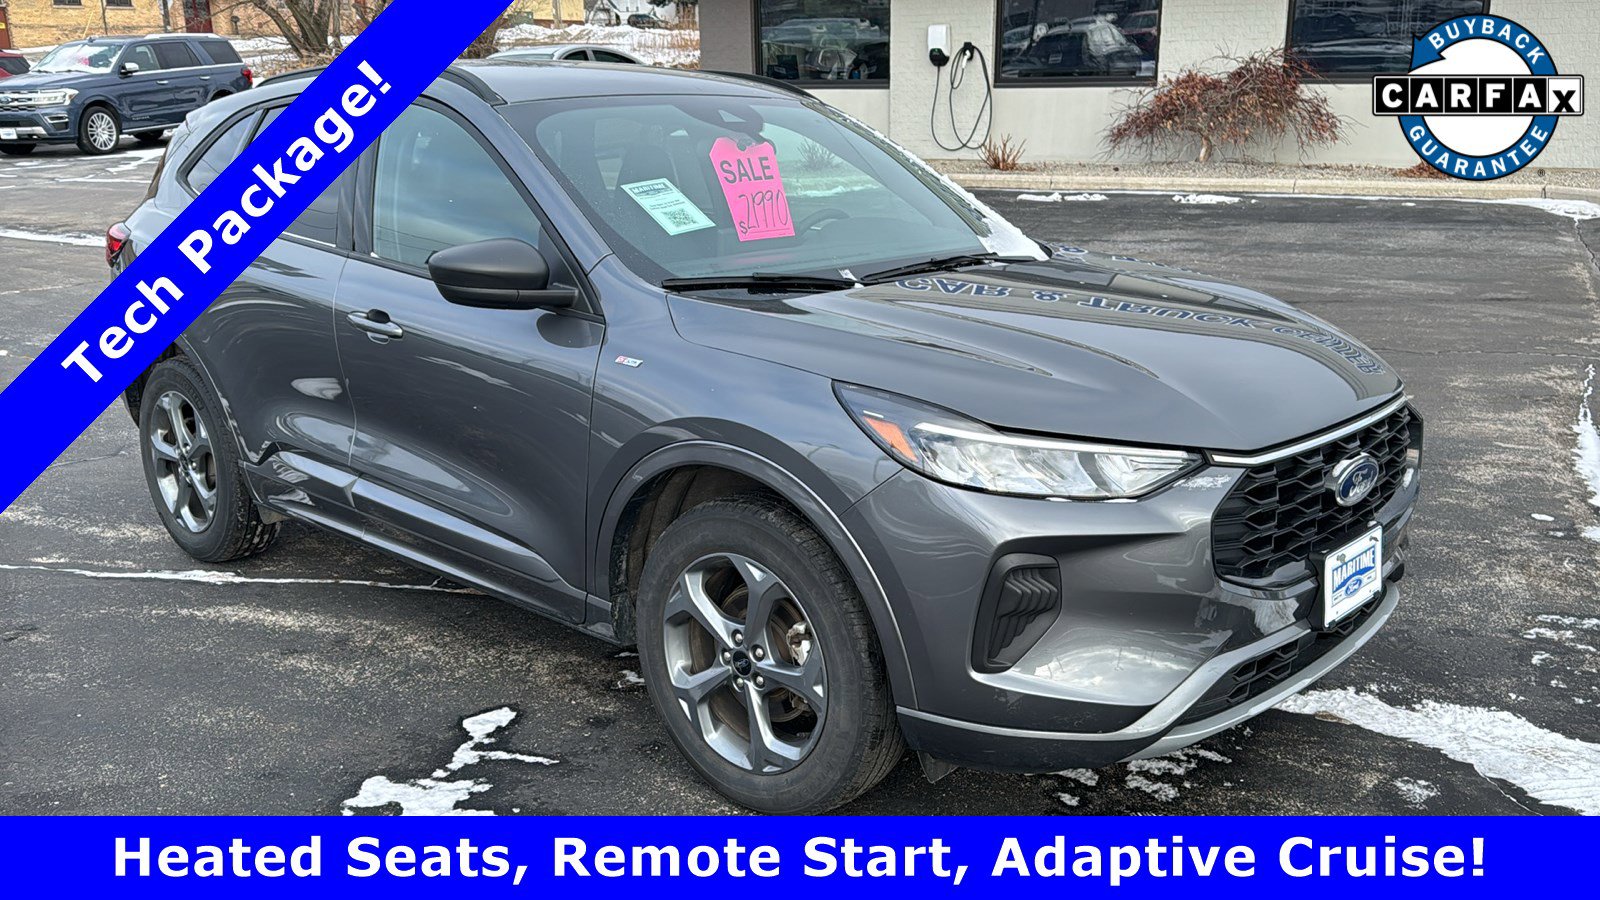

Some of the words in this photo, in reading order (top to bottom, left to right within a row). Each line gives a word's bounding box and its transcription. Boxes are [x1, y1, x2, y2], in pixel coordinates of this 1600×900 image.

[719, 156, 774, 184] SALE
[1347, 467, 1374, 499] Ford
[1333, 549, 1375, 592] MARITIME
